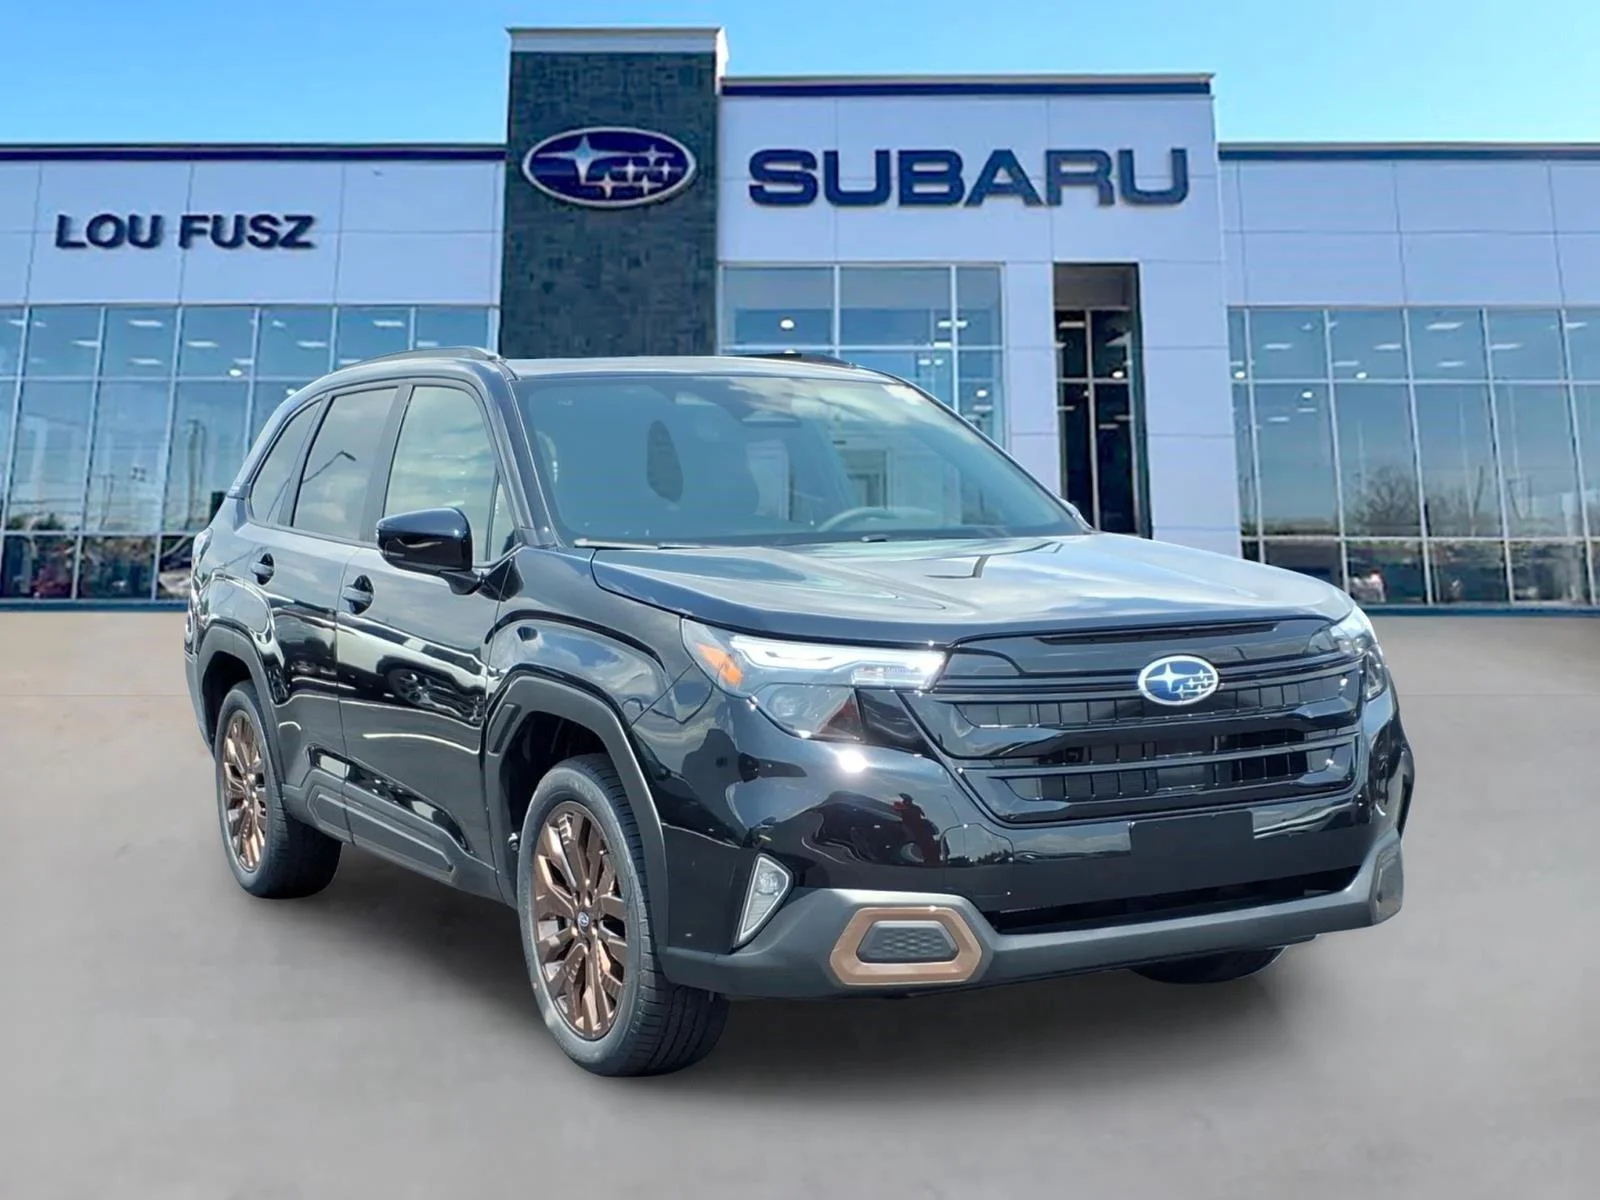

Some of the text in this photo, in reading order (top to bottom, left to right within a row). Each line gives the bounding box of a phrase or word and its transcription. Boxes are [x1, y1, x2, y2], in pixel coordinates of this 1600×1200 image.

[748, 148, 1189, 206] SUBARU
[55, 213, 315, 249] LOU FUSZ
